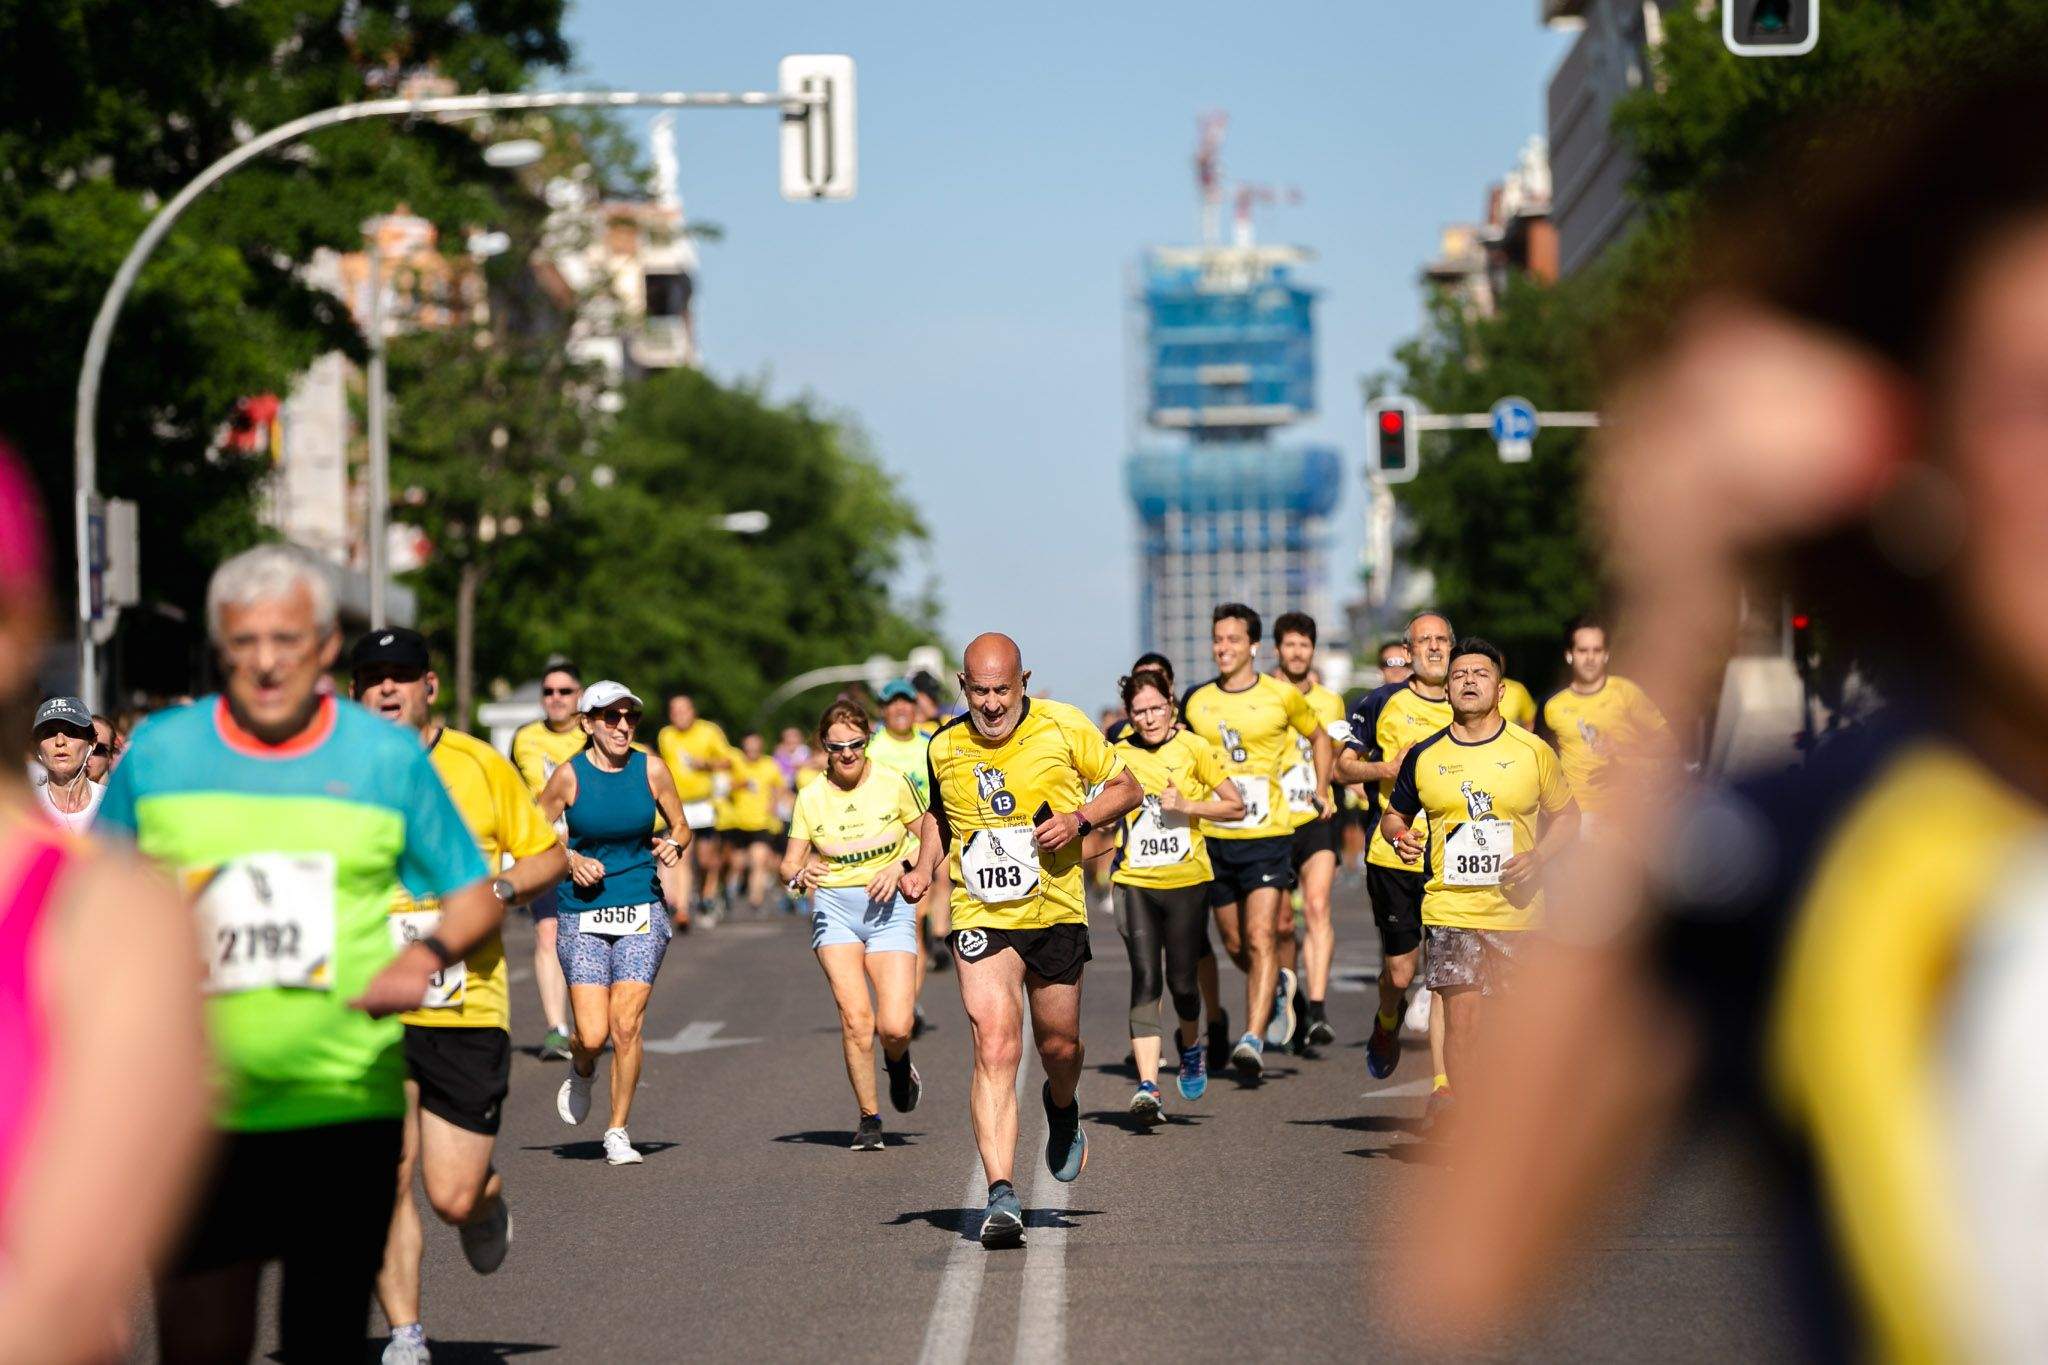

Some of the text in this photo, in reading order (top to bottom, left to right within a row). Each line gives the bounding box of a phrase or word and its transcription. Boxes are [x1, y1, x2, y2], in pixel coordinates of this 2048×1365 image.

[995, 795, 1012, 811] 13
[1140, 836, 1180, 857] 2943
[1457, 853, 1501, 874] 3837
[976, 865, 1021, 889] 1783
[592, 906, 637, 924] 3556
[217, 920, 300, 965] 2792
